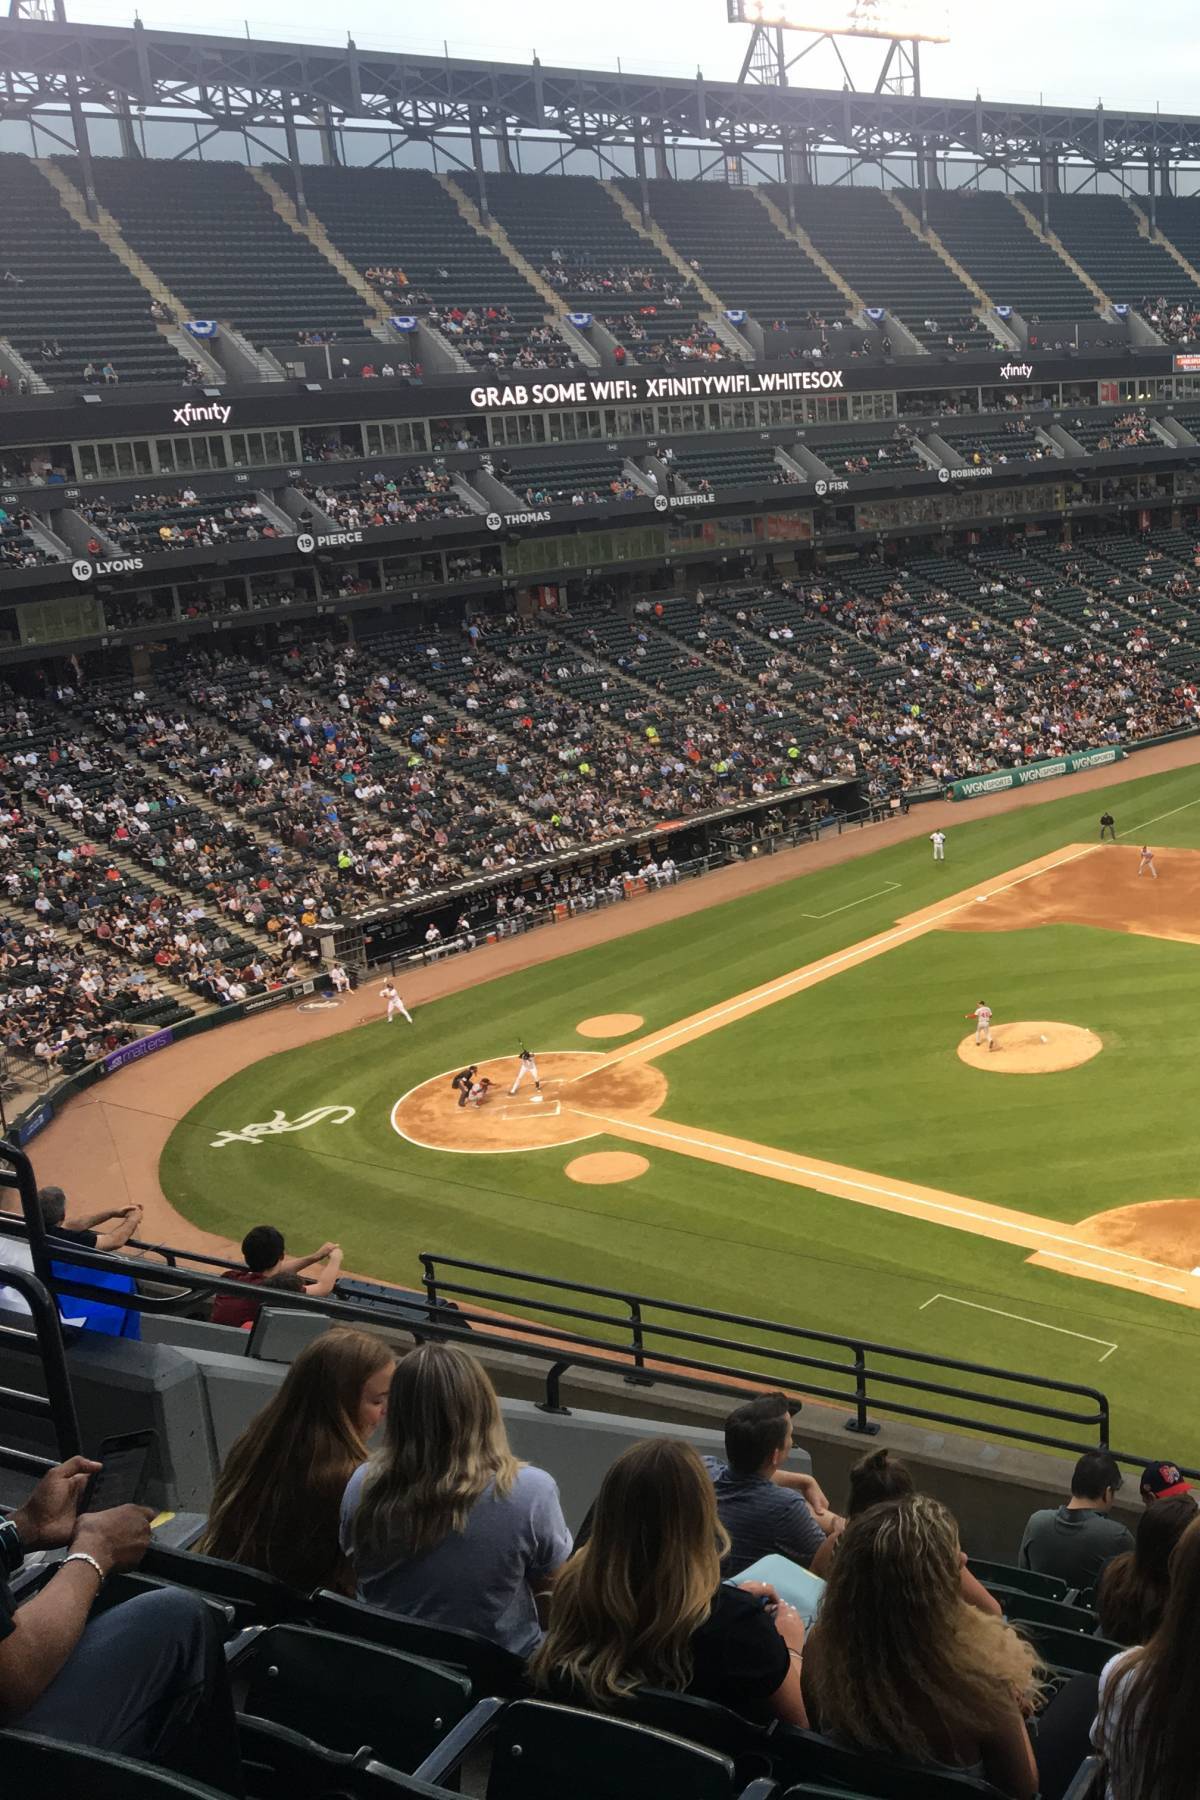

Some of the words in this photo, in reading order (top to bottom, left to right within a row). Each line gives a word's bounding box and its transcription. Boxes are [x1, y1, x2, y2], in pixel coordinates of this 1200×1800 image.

[1000, 362, 1033, 380] xfinity
[470, 386, 528, 408] GRAB
[533, 383, 587, 404] SOME
[590, 380, 637, 401] WIFI:
[646, 370, 844, 398] XFINITYWIFI_WHITESOX
[173, 403, 231, 426] xfinity
[951, 467, 993, 479] ROBINSON
[829, 480, 849, 491] FISK
[655, 499, 667, 508] 56
[669, 493, 716, 507] BUEHRLE
[487, 516, 500, 526] 35
[503, 510, 552, 525] THOMAS
[300, 538, 312, 549] 19
[317, 531, 363, 547] PIERCE
[75, 564, 90, 577] 16
[96, 558, 144, 574] LYONS
[1072, 757, 1093, 770] WGN
[1093, 752, 1115, 764] SPORTS
[1019, 770, 1042, 783] WGN
[1042, 764, 1065, 777] SPORTS
[962, 784, 986, 795] WGN
[987, 777, 1012, 789] SPORTS
[578, 838, 626, 852] HOME
[523, 858, 557, 869] THE
[450, 867, 523, 891] CHICAGO
[390, 890, 449, 907] WHITE
[350, 907, 389, 920] SOX
